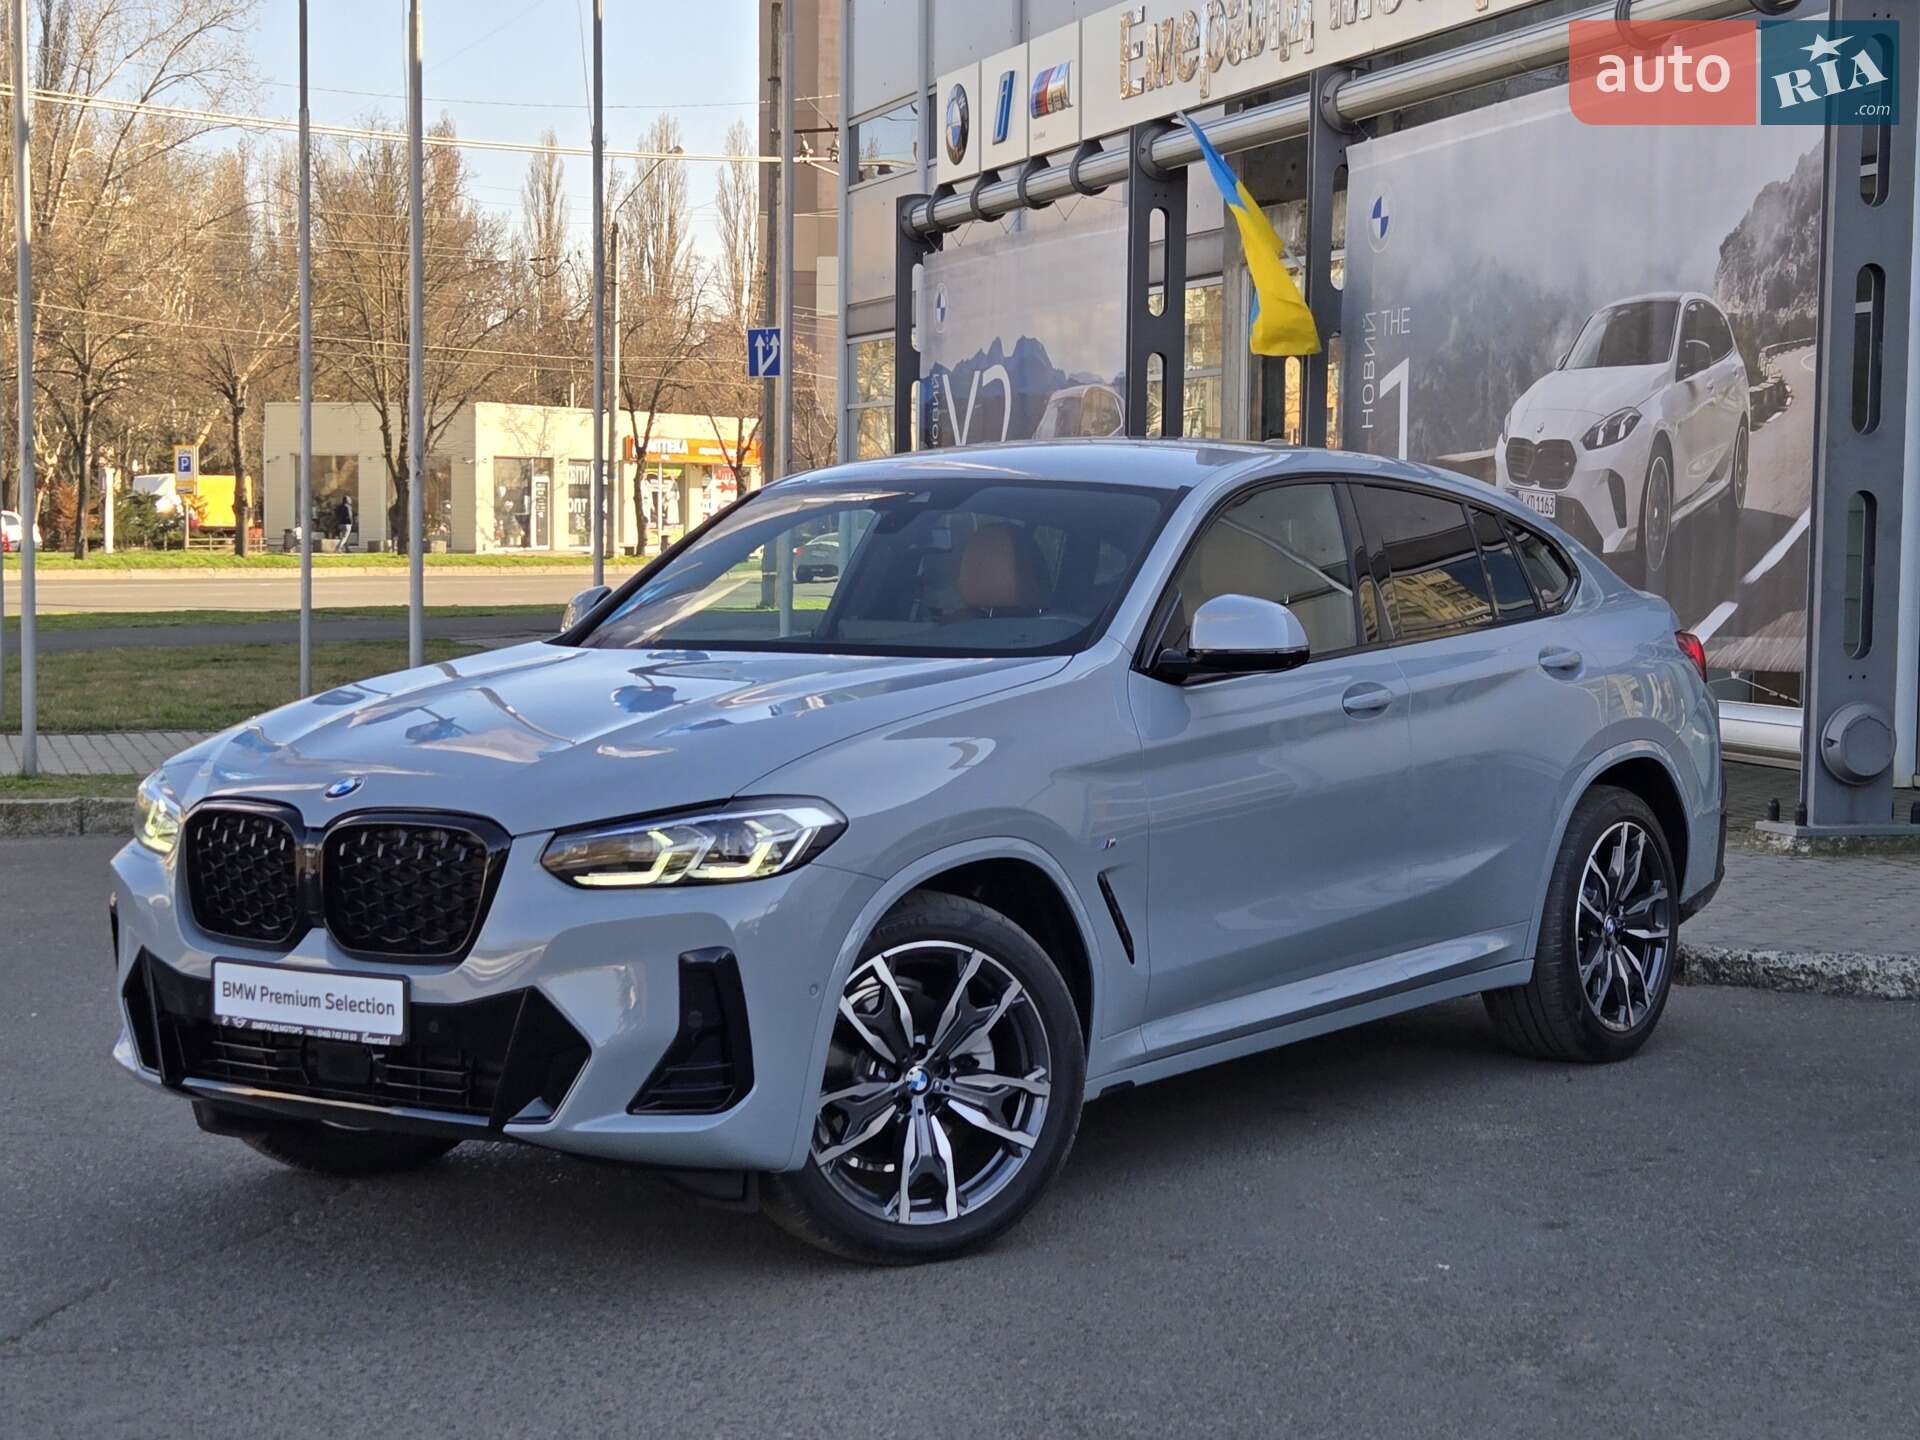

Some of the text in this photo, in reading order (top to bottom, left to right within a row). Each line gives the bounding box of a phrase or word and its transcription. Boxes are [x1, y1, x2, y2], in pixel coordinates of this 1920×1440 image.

[1381, 307, 1411, 336] THE
[1361, 312, 1377, 429] НОВИЙ
[223, 981, 395, 1016] BMW Premium Selection
